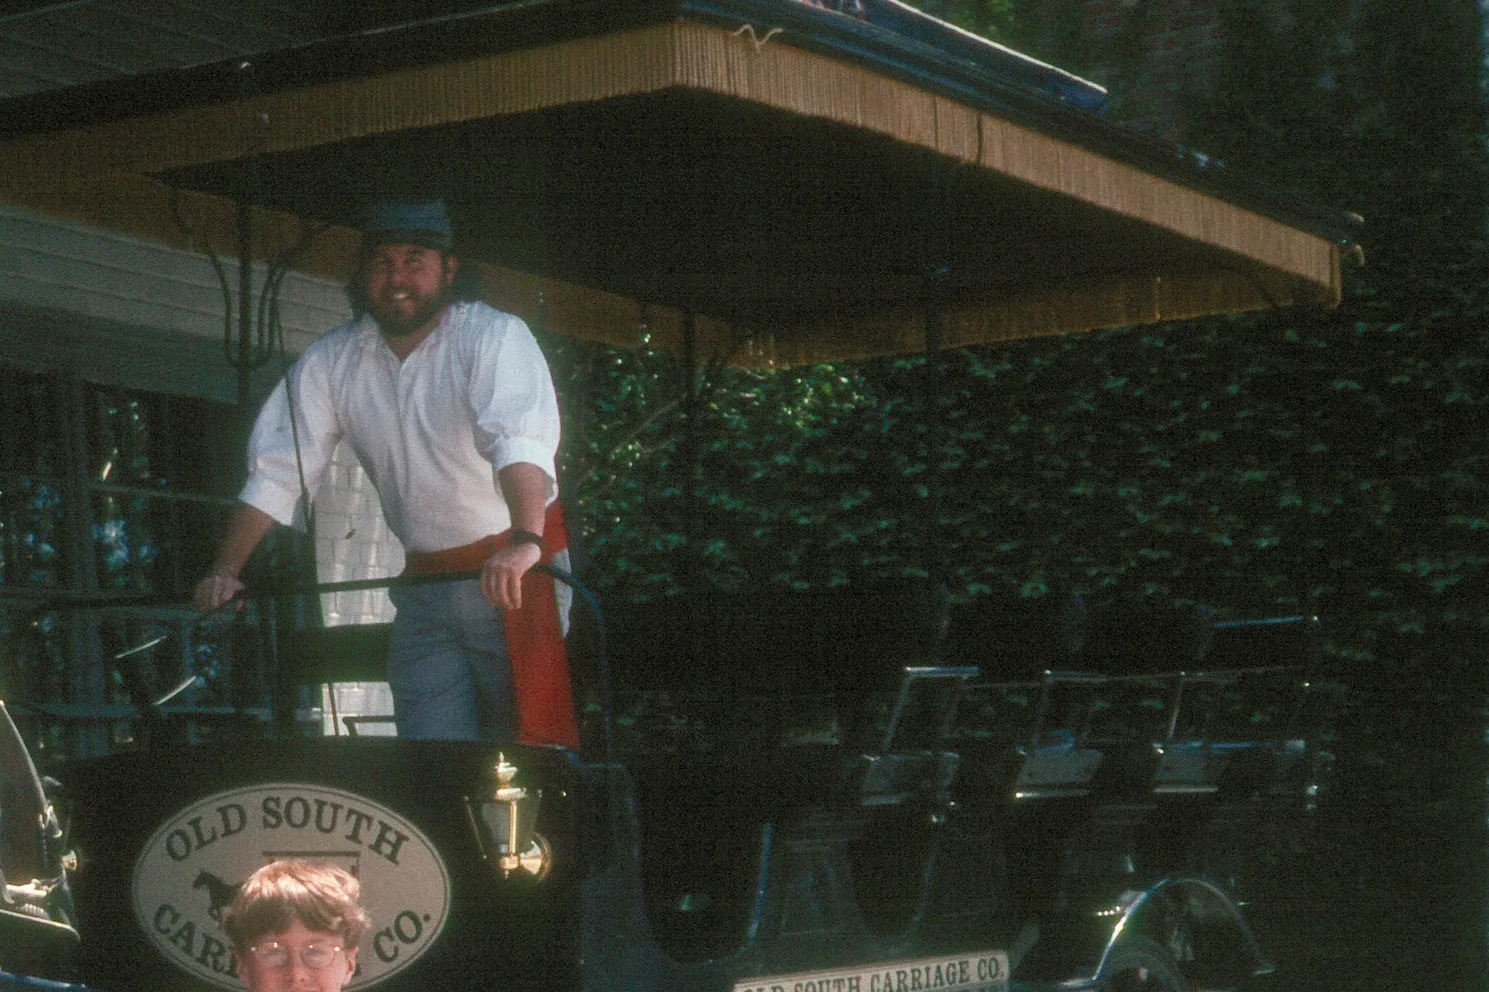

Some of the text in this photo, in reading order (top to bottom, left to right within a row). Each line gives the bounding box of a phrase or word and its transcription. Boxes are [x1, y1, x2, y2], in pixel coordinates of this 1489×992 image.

[165, 796, 410, 865] OLD SOUTH
[373, 910, 431, 963] CO.
[977, 957, 1004, 981] CO.
